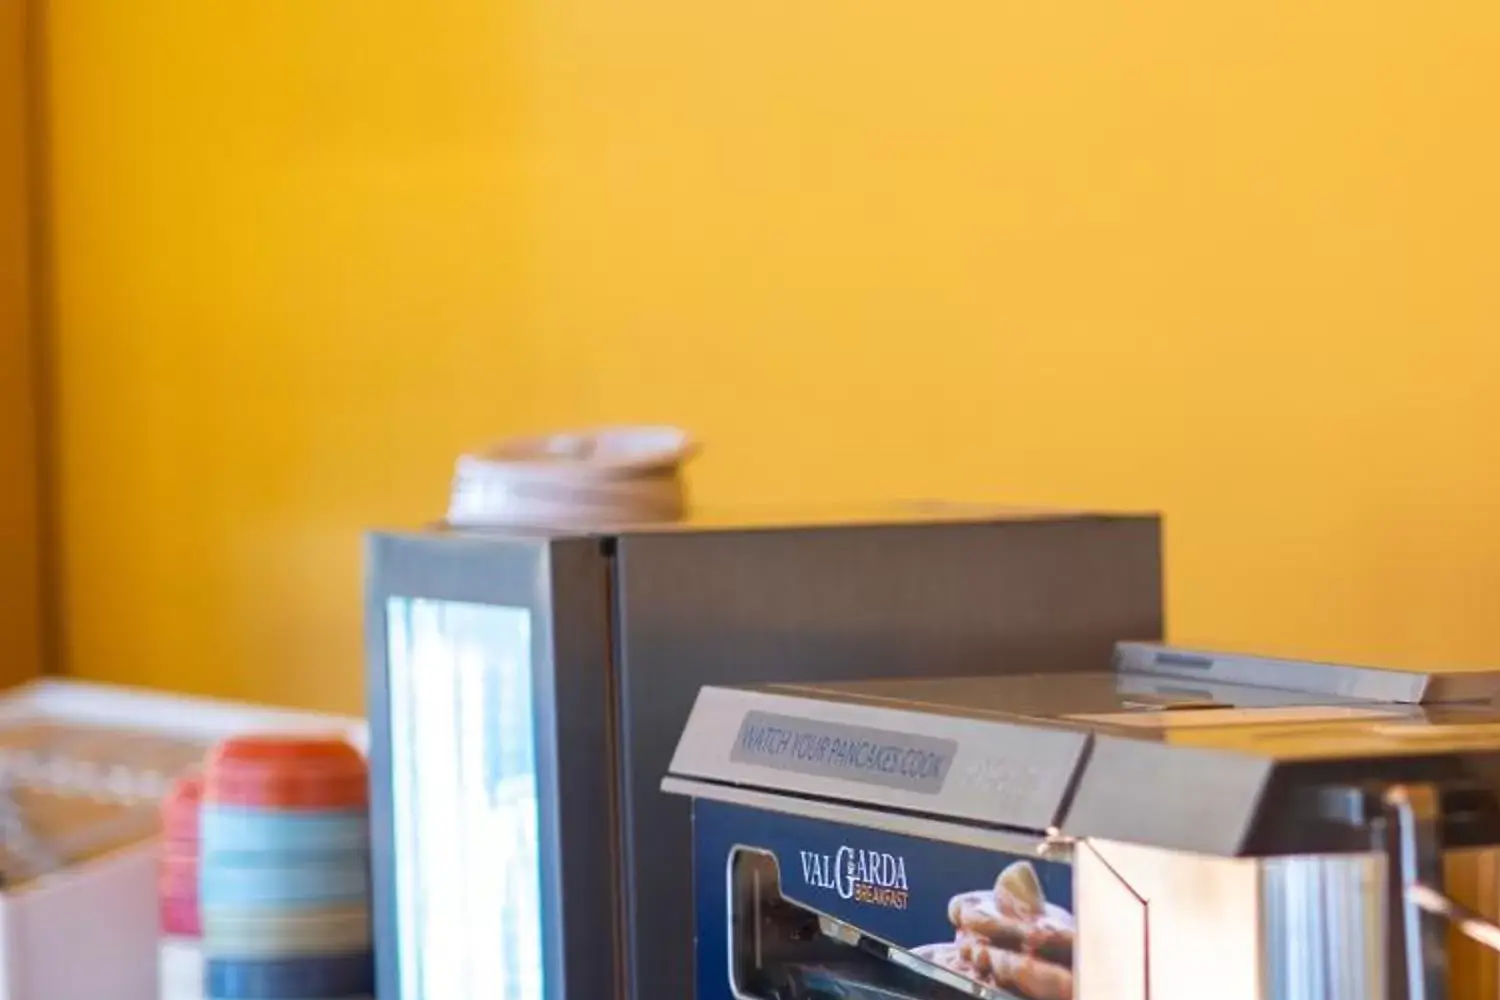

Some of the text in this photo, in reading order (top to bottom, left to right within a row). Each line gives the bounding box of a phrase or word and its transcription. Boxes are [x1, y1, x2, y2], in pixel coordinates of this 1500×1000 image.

[741, 725, 947, 779] WATCH YOUR PANCAKES COOK
